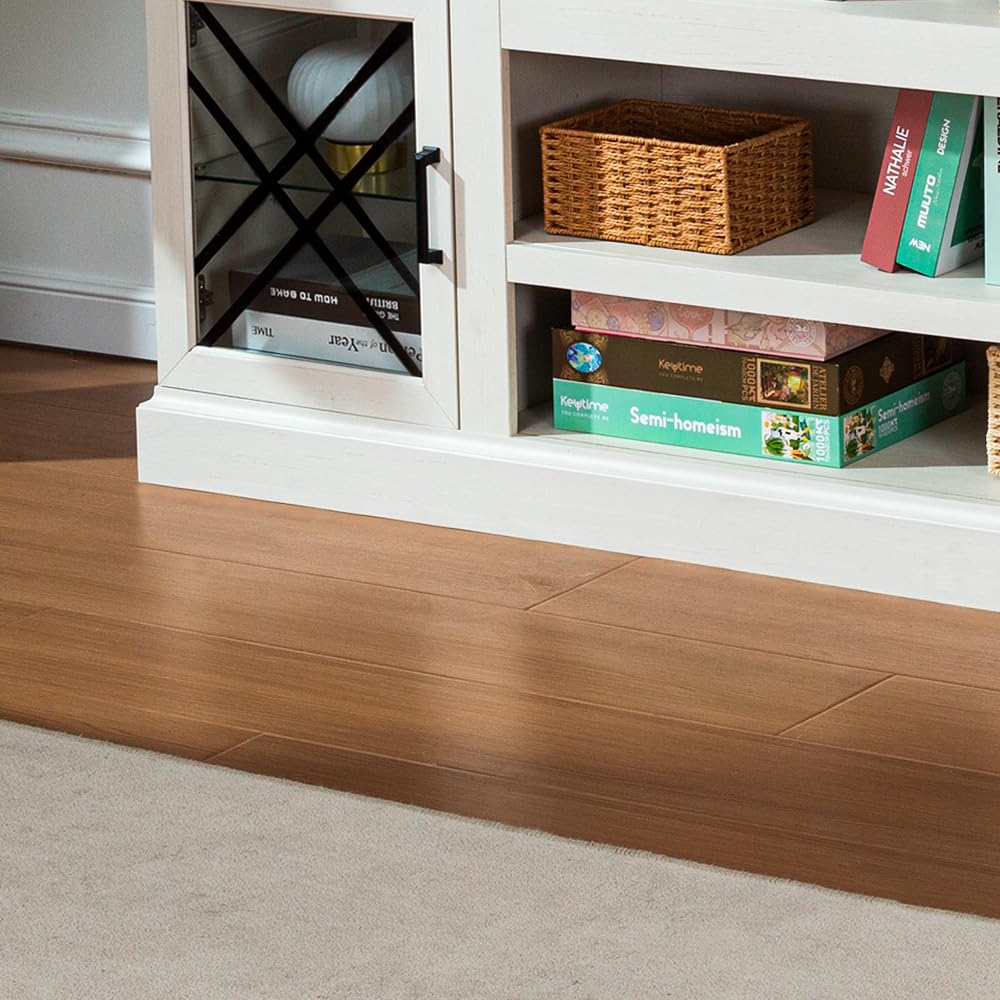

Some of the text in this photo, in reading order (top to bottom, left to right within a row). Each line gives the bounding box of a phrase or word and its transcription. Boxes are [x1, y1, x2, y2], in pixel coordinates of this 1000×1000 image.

[936, 119, 951, 156] DESIGN
[883, 125, 910, 196] NATHALIE
[908, 237, 932, 253] NEW
[300, 291, 312, 301] TO
[314, 294, 338, 304] HOW
[251, 325, 275, 338] TIME
[328, 335, 358, 352] Year
[819, 366, 828, 411] ATELIER
[560, 396, 609, 413] Keytime
[877, 391, 931, 422] Semi-homeism
[630, 406, 742, 439] Semi-homeism
